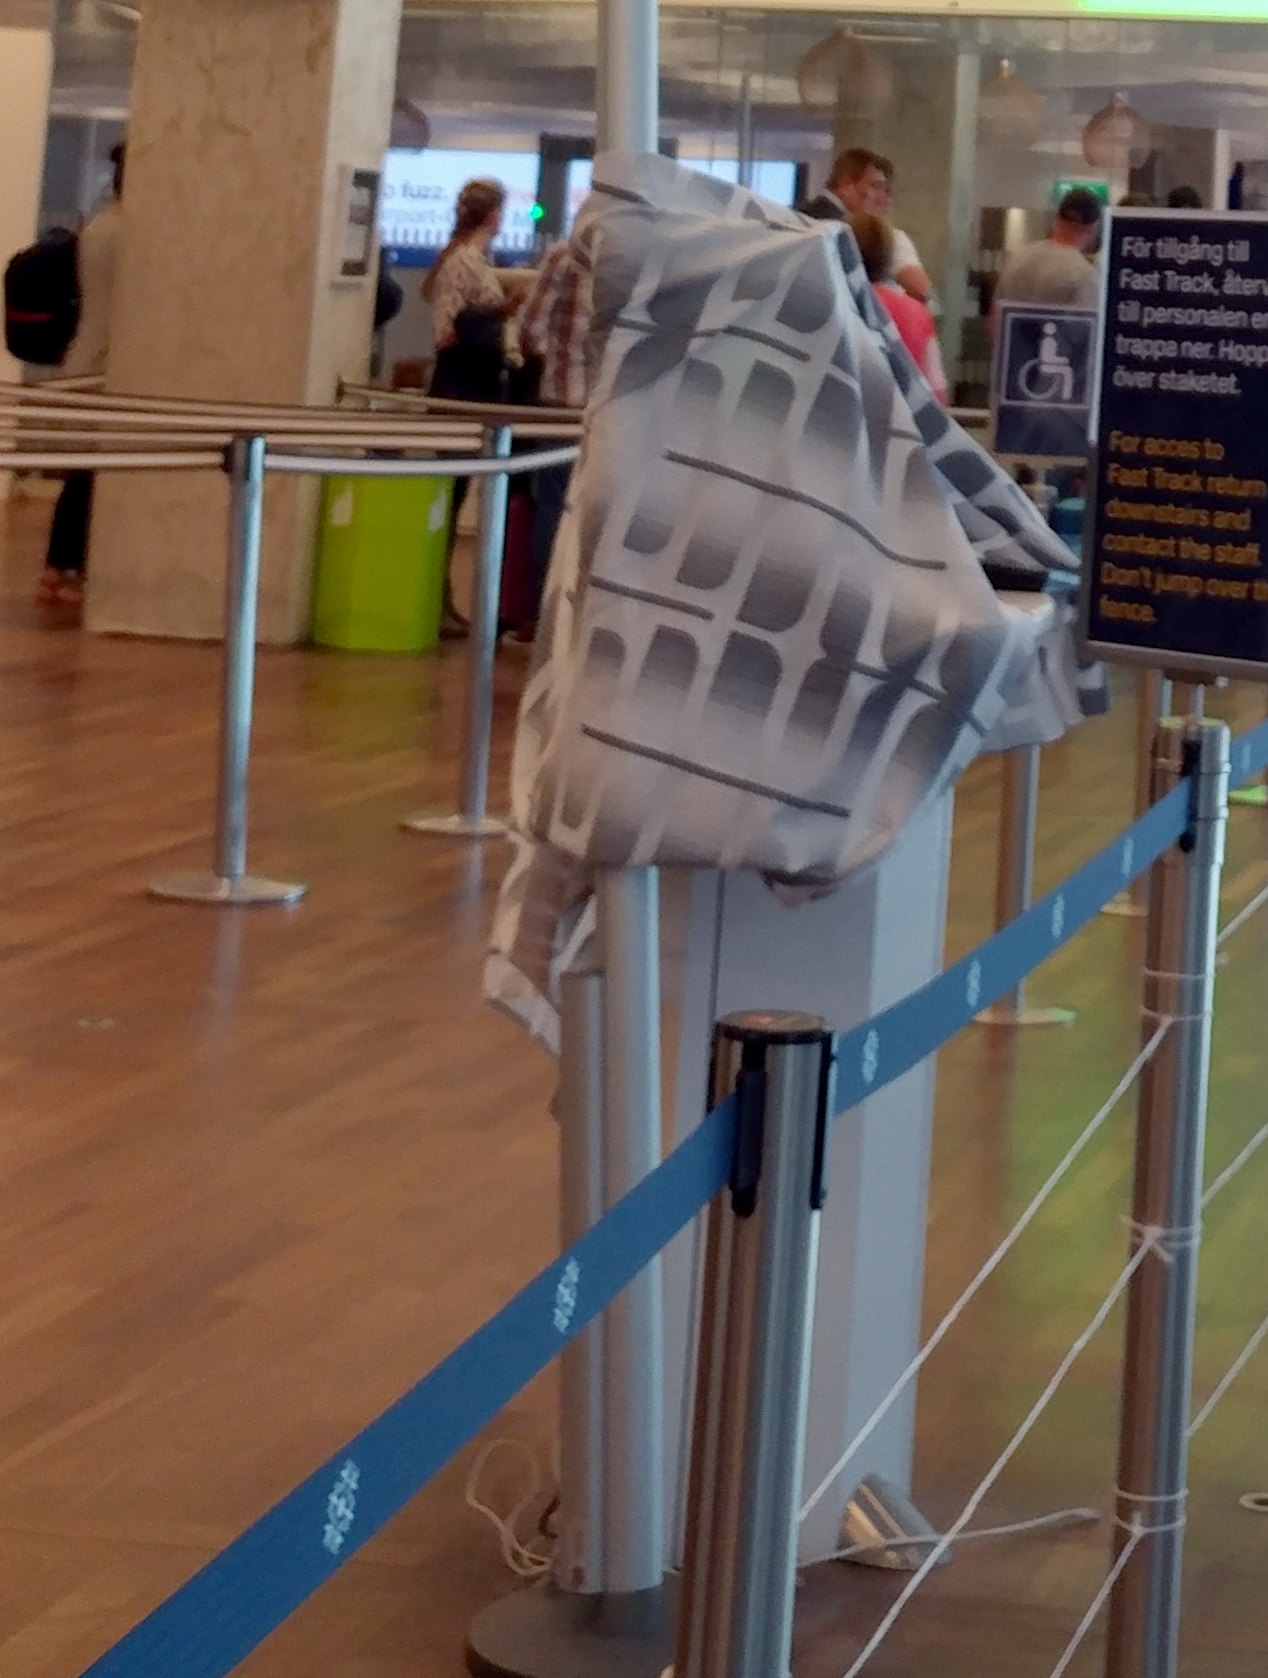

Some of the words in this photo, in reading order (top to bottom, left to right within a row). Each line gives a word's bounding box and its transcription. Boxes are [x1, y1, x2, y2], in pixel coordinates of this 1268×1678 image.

[1121, 235, 1152, 258] För
[1156, 235, 1224, 266] tillgång
[1227, 238, 1250, 262] till
[1119, 268, 1160, 290] Fast
[1164, 270, 1219, 296] Track,
[1117, 300, 1141, 323] till
[1143, 305, 1249, 328] personalen
[1115, 333, 1178, 360] trappa
[1180, 340, 1215, 359] ner.
[1112, 364, 1155, 389] över
[1158, 369, 1242, 394] staketet.
[1110, 430, 1140, 452] For
[1204, 438, 1225, 461] to
[1107, 463, 1148, 486] Fast
[1153, 467, 1203, 492] Track
[1206, 474, 1268, 497] return
[1213, 508, 1251, 531] and
[1102, 534, 1176, 557] contact
[1179, 538, 1212, 561] the
[1153, 572, 1205, 598] jump
[1206, 578, 1249, 599] over
[1099, 595, 1157, 622] fence.
